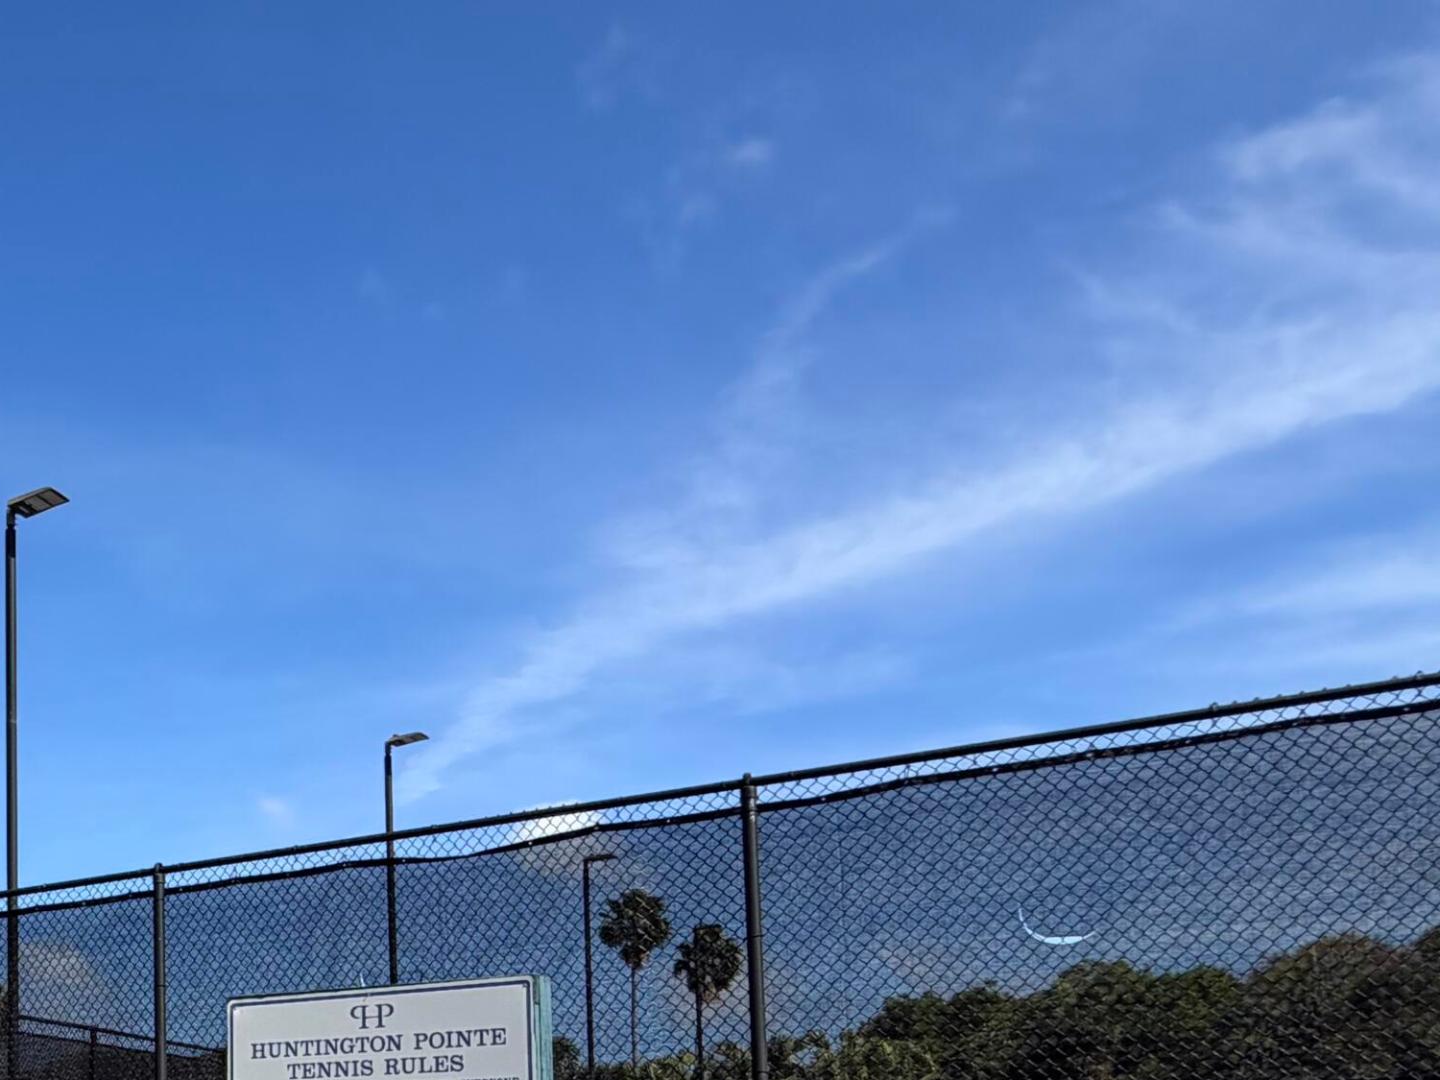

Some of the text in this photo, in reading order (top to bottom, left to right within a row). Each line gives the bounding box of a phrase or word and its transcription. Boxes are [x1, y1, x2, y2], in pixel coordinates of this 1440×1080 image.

[250, 1028, 507, 1059] HUNTINGTON POINTE
[287, 1055, 465, 1080] TENNIS RULES
